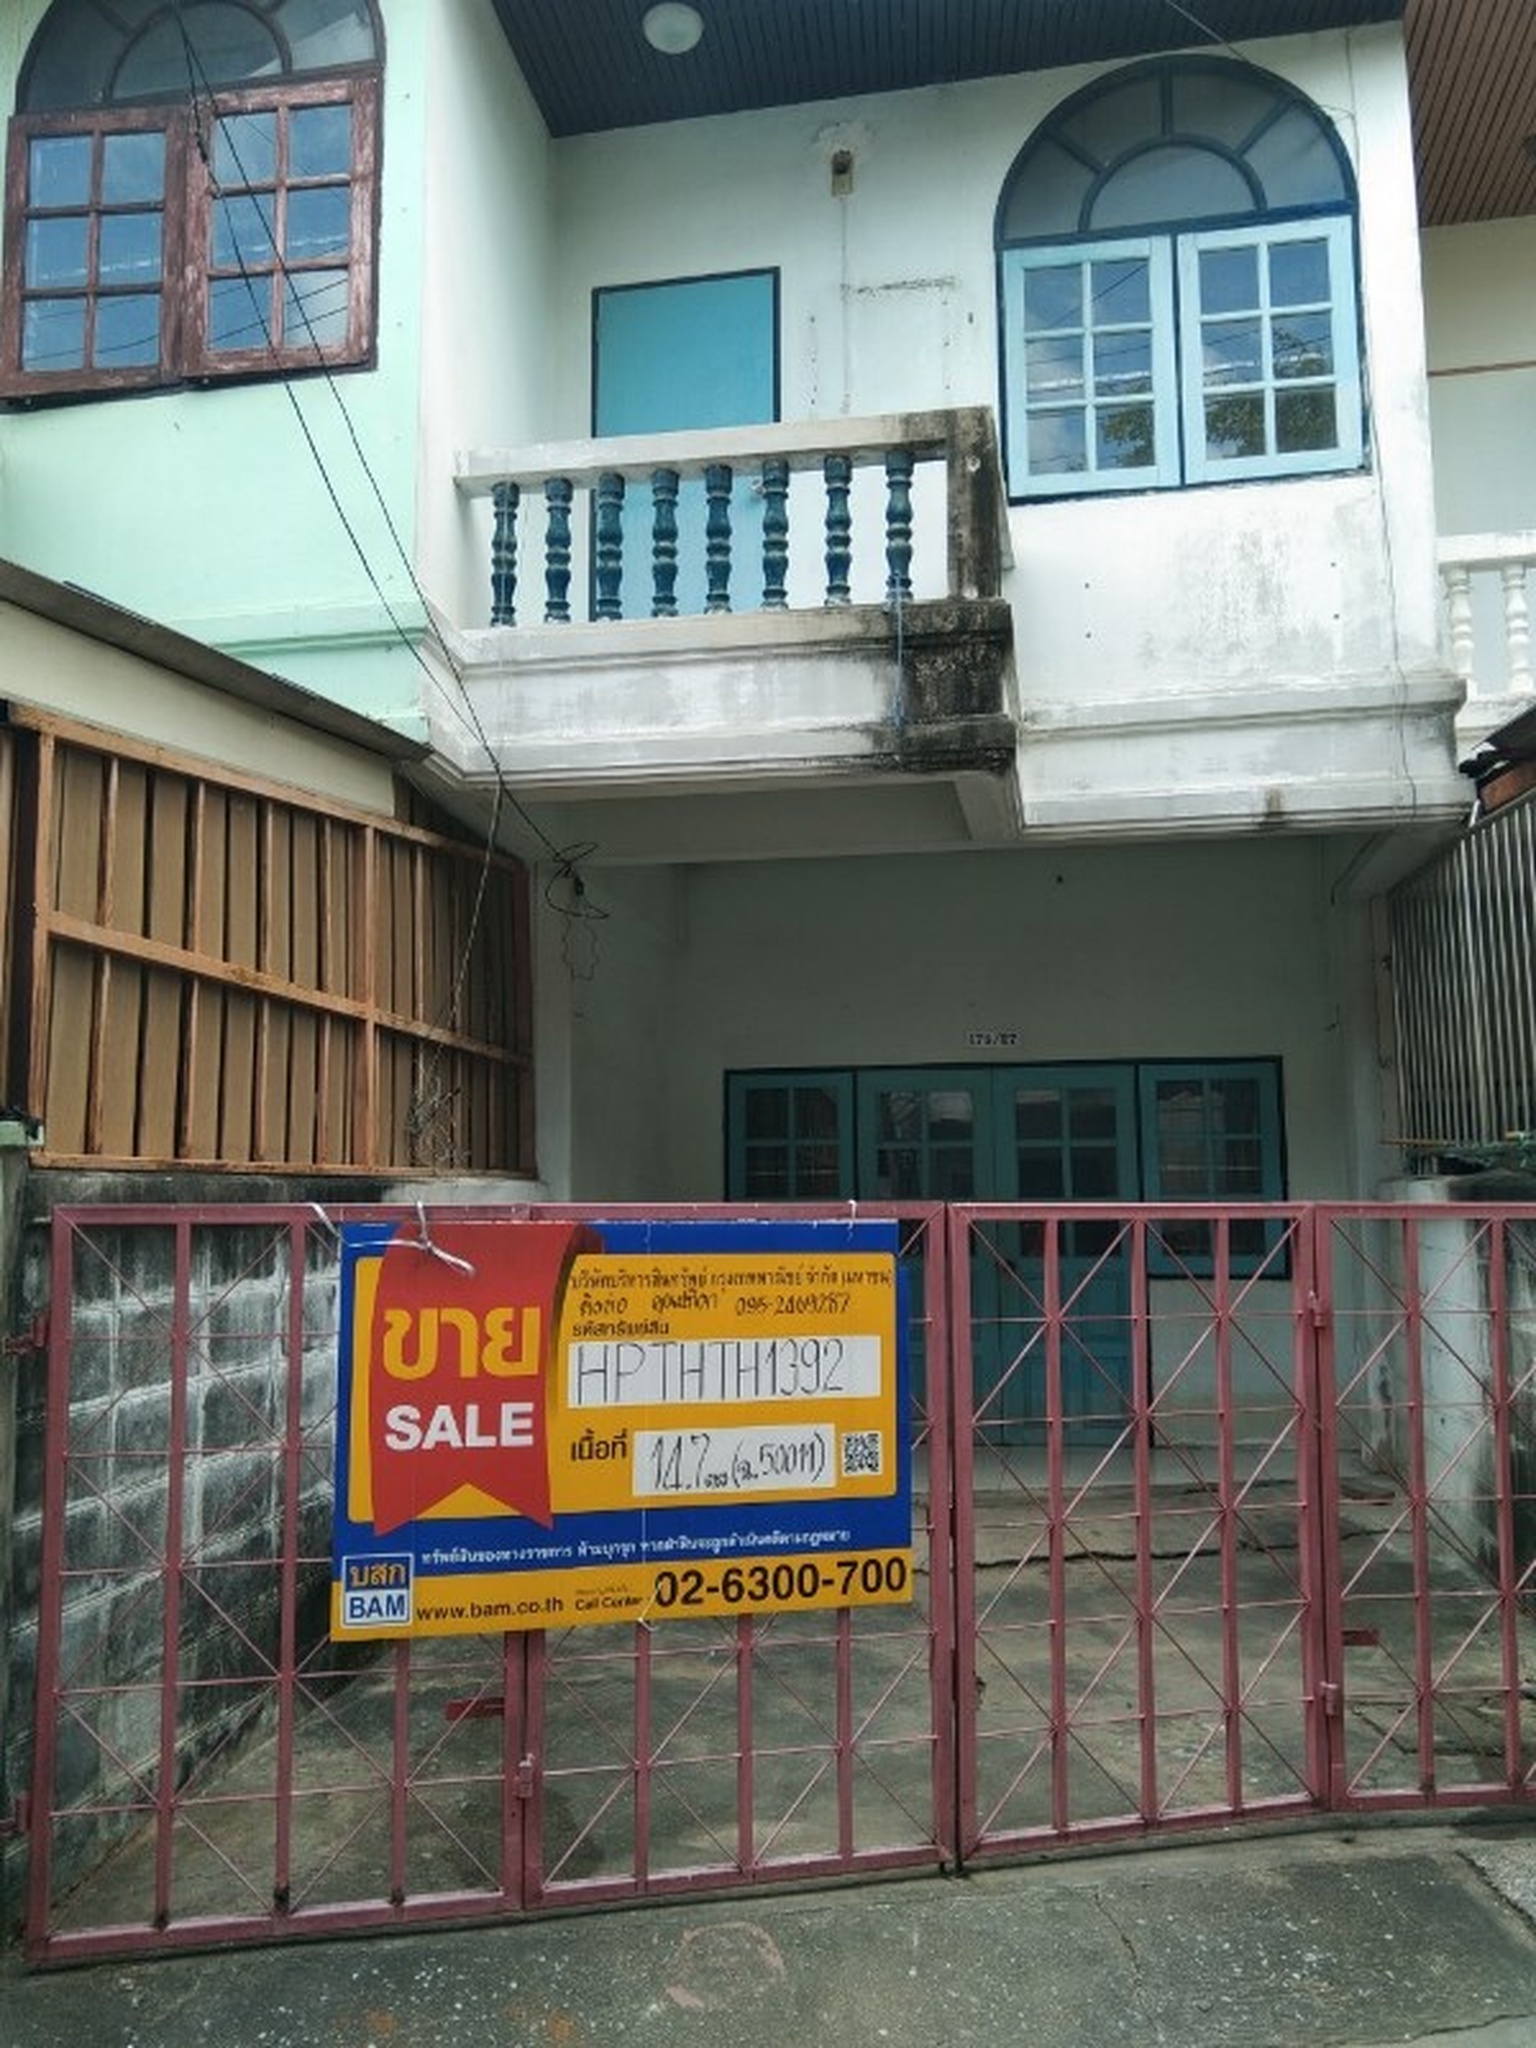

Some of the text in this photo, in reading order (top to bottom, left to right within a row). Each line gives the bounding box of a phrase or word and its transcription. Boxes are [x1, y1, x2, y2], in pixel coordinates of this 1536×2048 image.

[383, 1306, 541, 1381] ขาย
[577, 1338, 845, 1406] HPTHTH1392
[385, 1402, 534, 1451] SALE
[570, 1428, 627, 1461] เนื้อที่
[350, 1562, 406, 1588] บสก
[653, 1557, 907, 1608] 02-6300-700
[350, 1594, 406, 1620] BAM
[416, 1597, 564, 1621] www.bam.co.th
